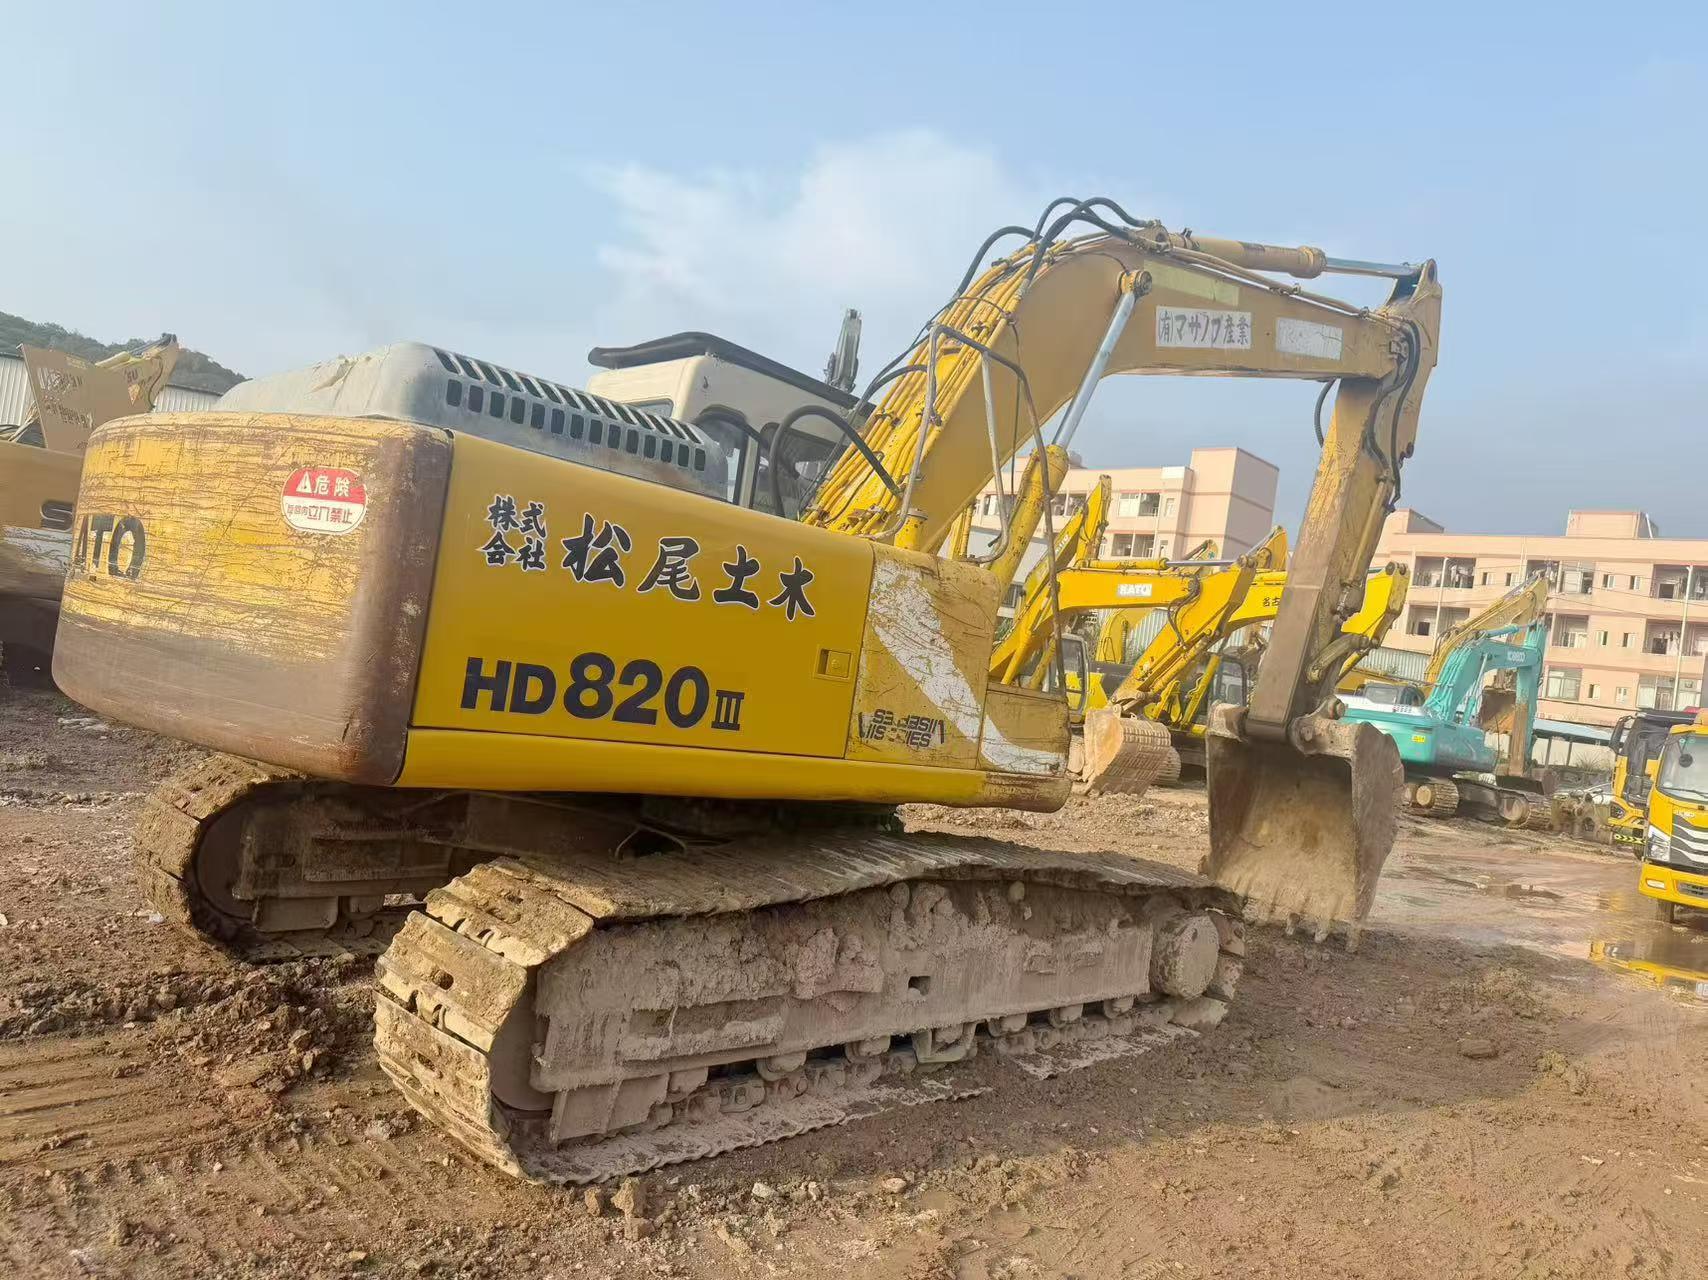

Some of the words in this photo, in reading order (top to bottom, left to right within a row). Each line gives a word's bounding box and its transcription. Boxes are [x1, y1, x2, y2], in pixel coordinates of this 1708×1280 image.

[314, 475, 350, 497] 危険
[487, 494, 547, 539] 株式
[478, 530, 547, 572] 会社
[562, 512, 816, 621] 松尾土木
